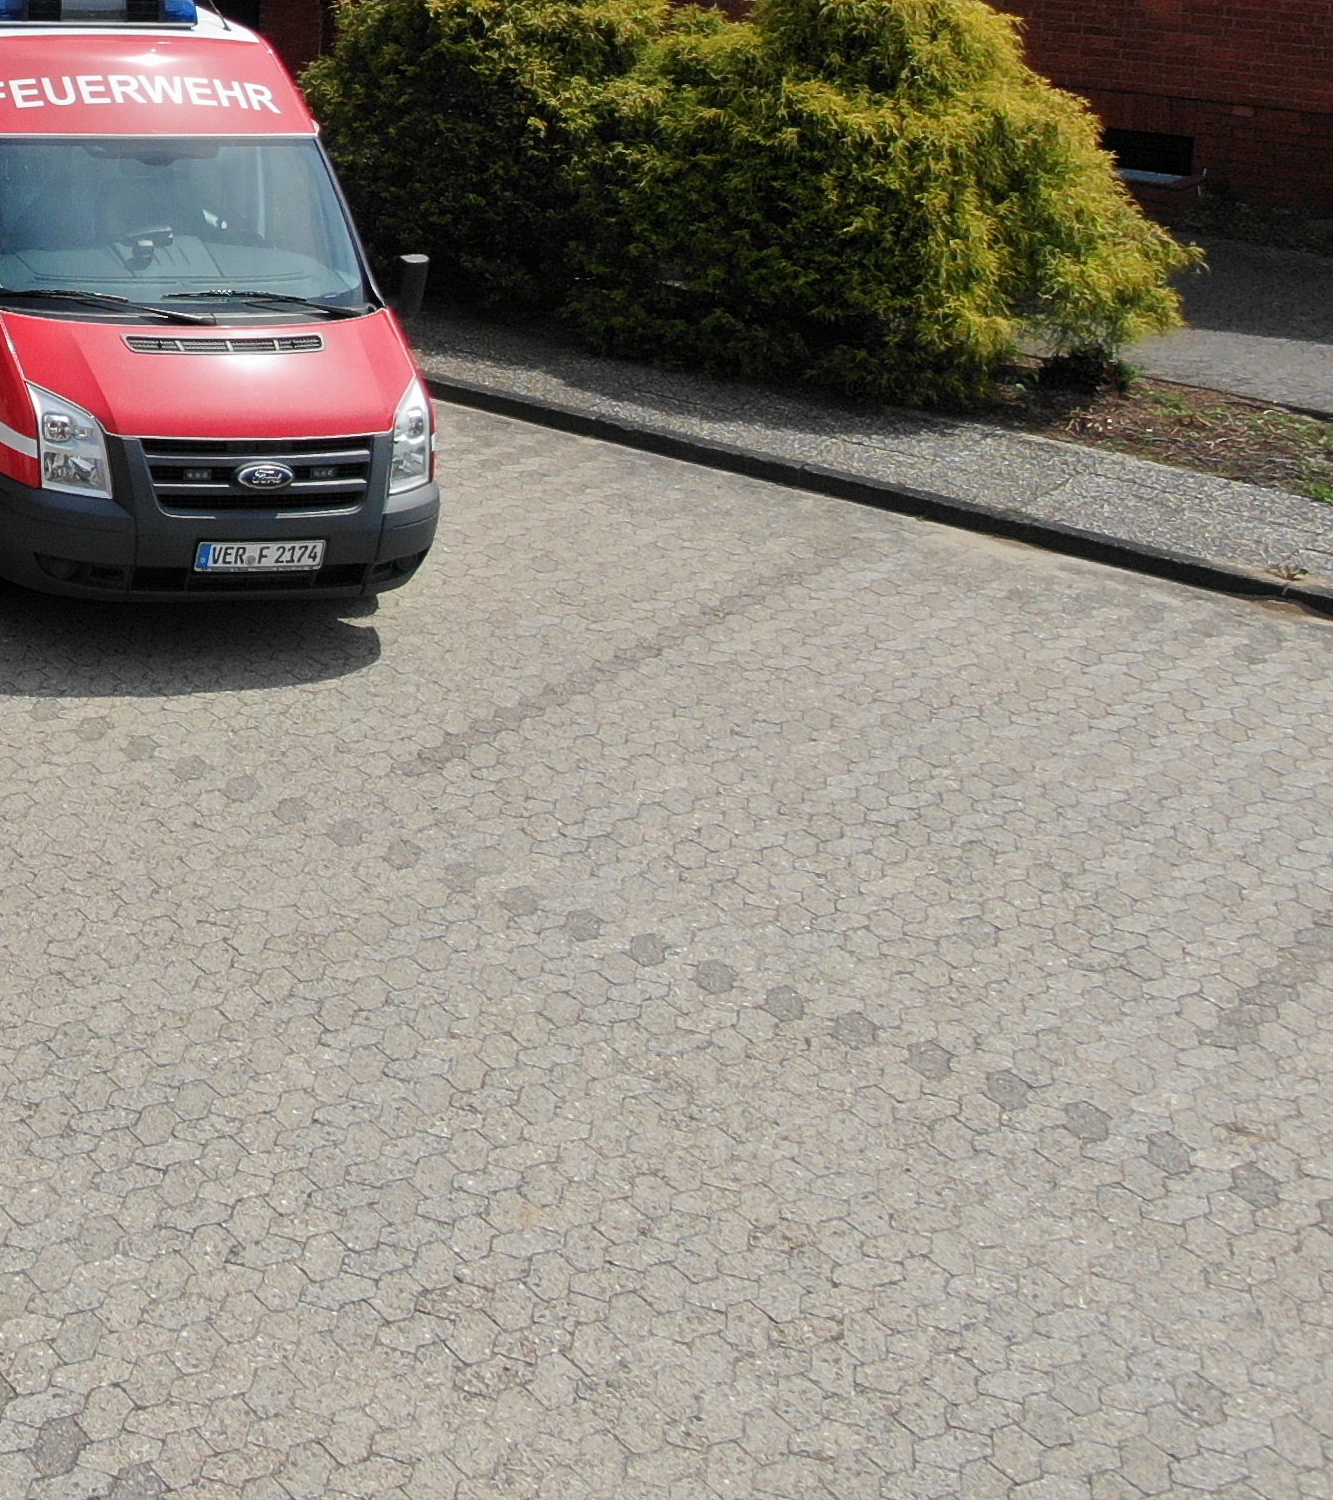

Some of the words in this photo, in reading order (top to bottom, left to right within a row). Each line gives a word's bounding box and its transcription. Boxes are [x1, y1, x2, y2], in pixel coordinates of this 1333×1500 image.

[211, 546, 247, 565] VER
[257, 546, 271, 565] F
[274, 544, 319, 564] 2174
